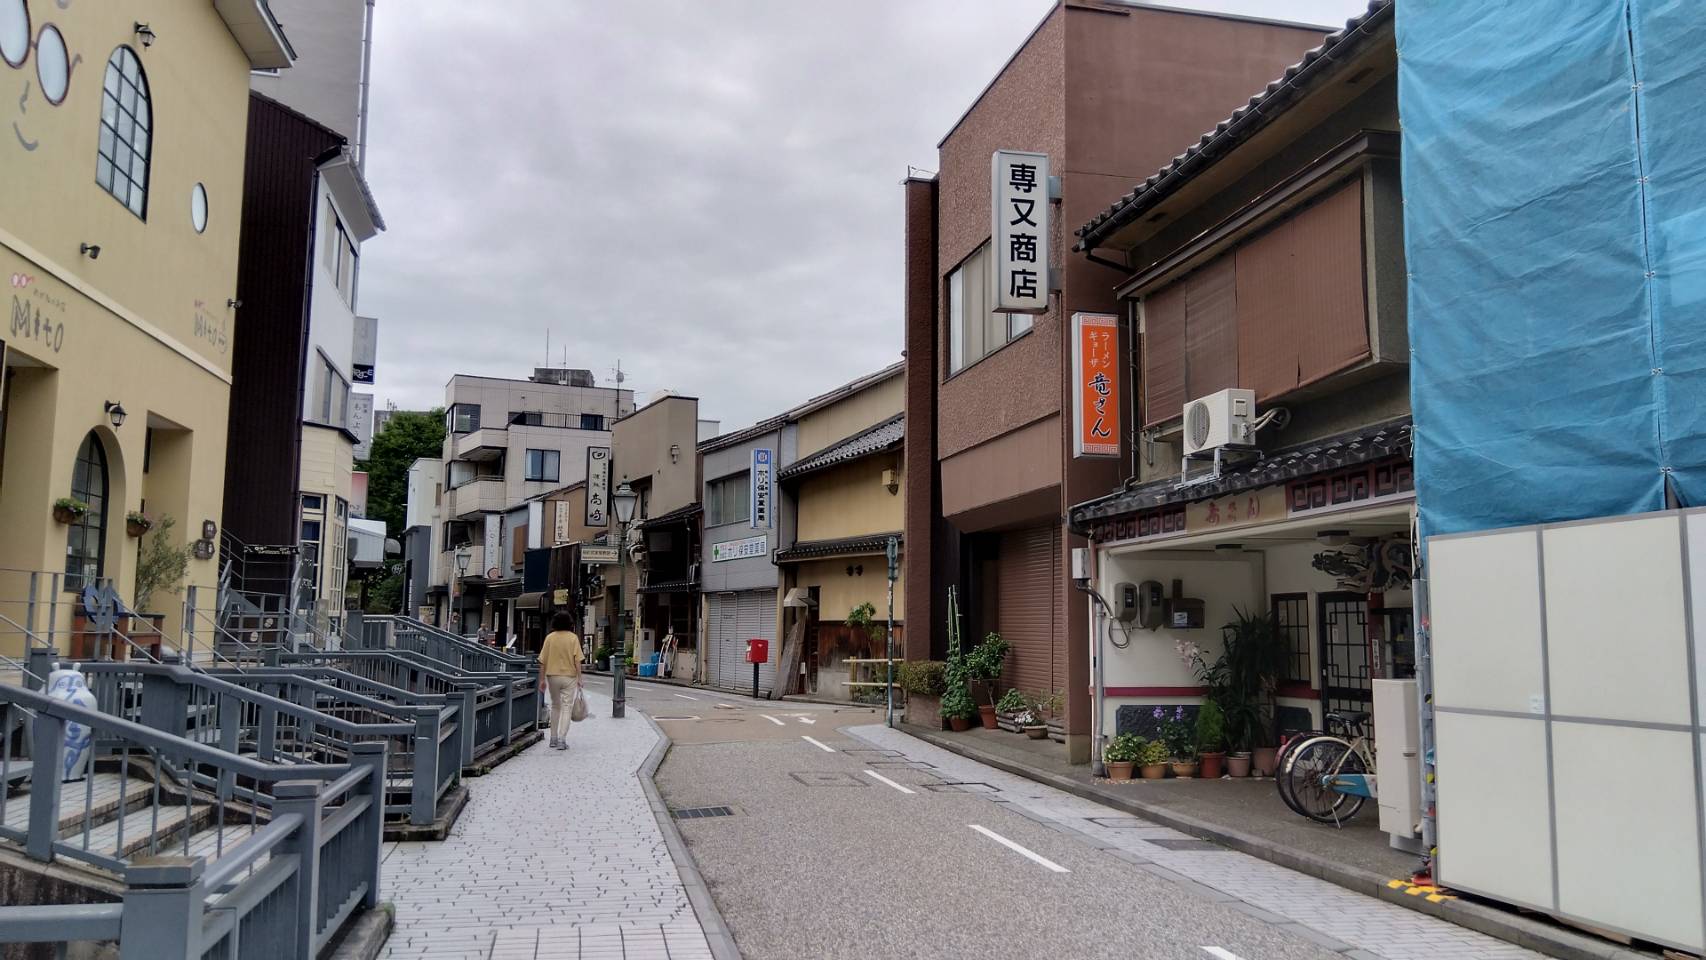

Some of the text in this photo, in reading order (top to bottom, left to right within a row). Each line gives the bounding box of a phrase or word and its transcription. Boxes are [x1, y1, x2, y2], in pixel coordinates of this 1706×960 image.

[1009, 163, 1037, 299] 専又商店
[1101, 331, 1112, 368] ラーメン
